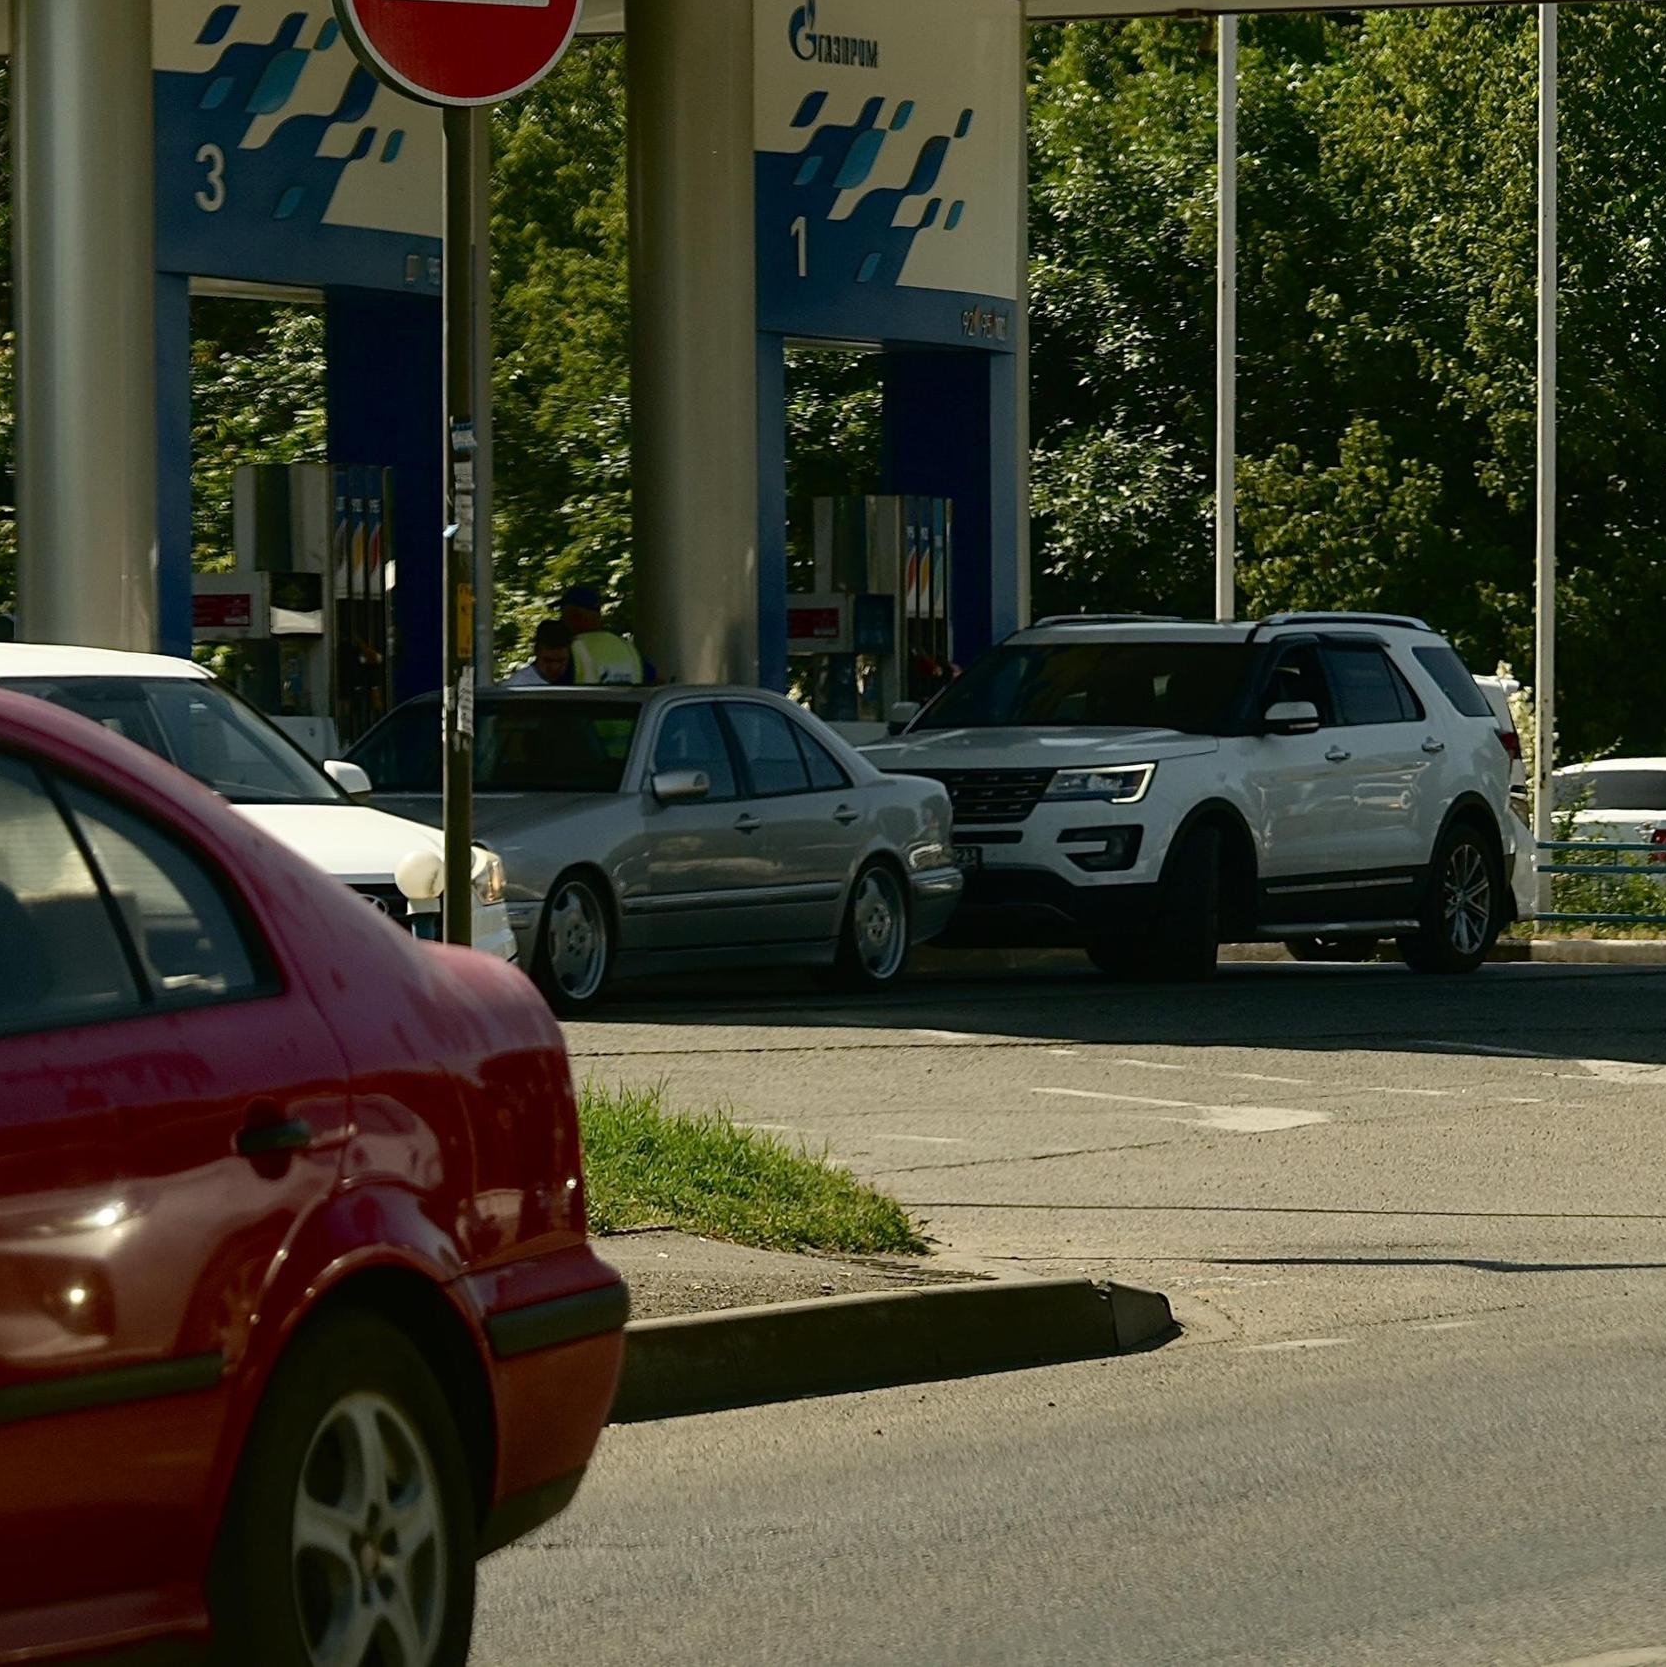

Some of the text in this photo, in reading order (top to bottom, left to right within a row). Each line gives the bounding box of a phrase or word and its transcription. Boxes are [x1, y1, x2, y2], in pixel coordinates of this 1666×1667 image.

[818, 35, 878, 68] ГАЗПРОМ
[194, 143, 225, 213] 3
[790, 216, 808, 277] 1
